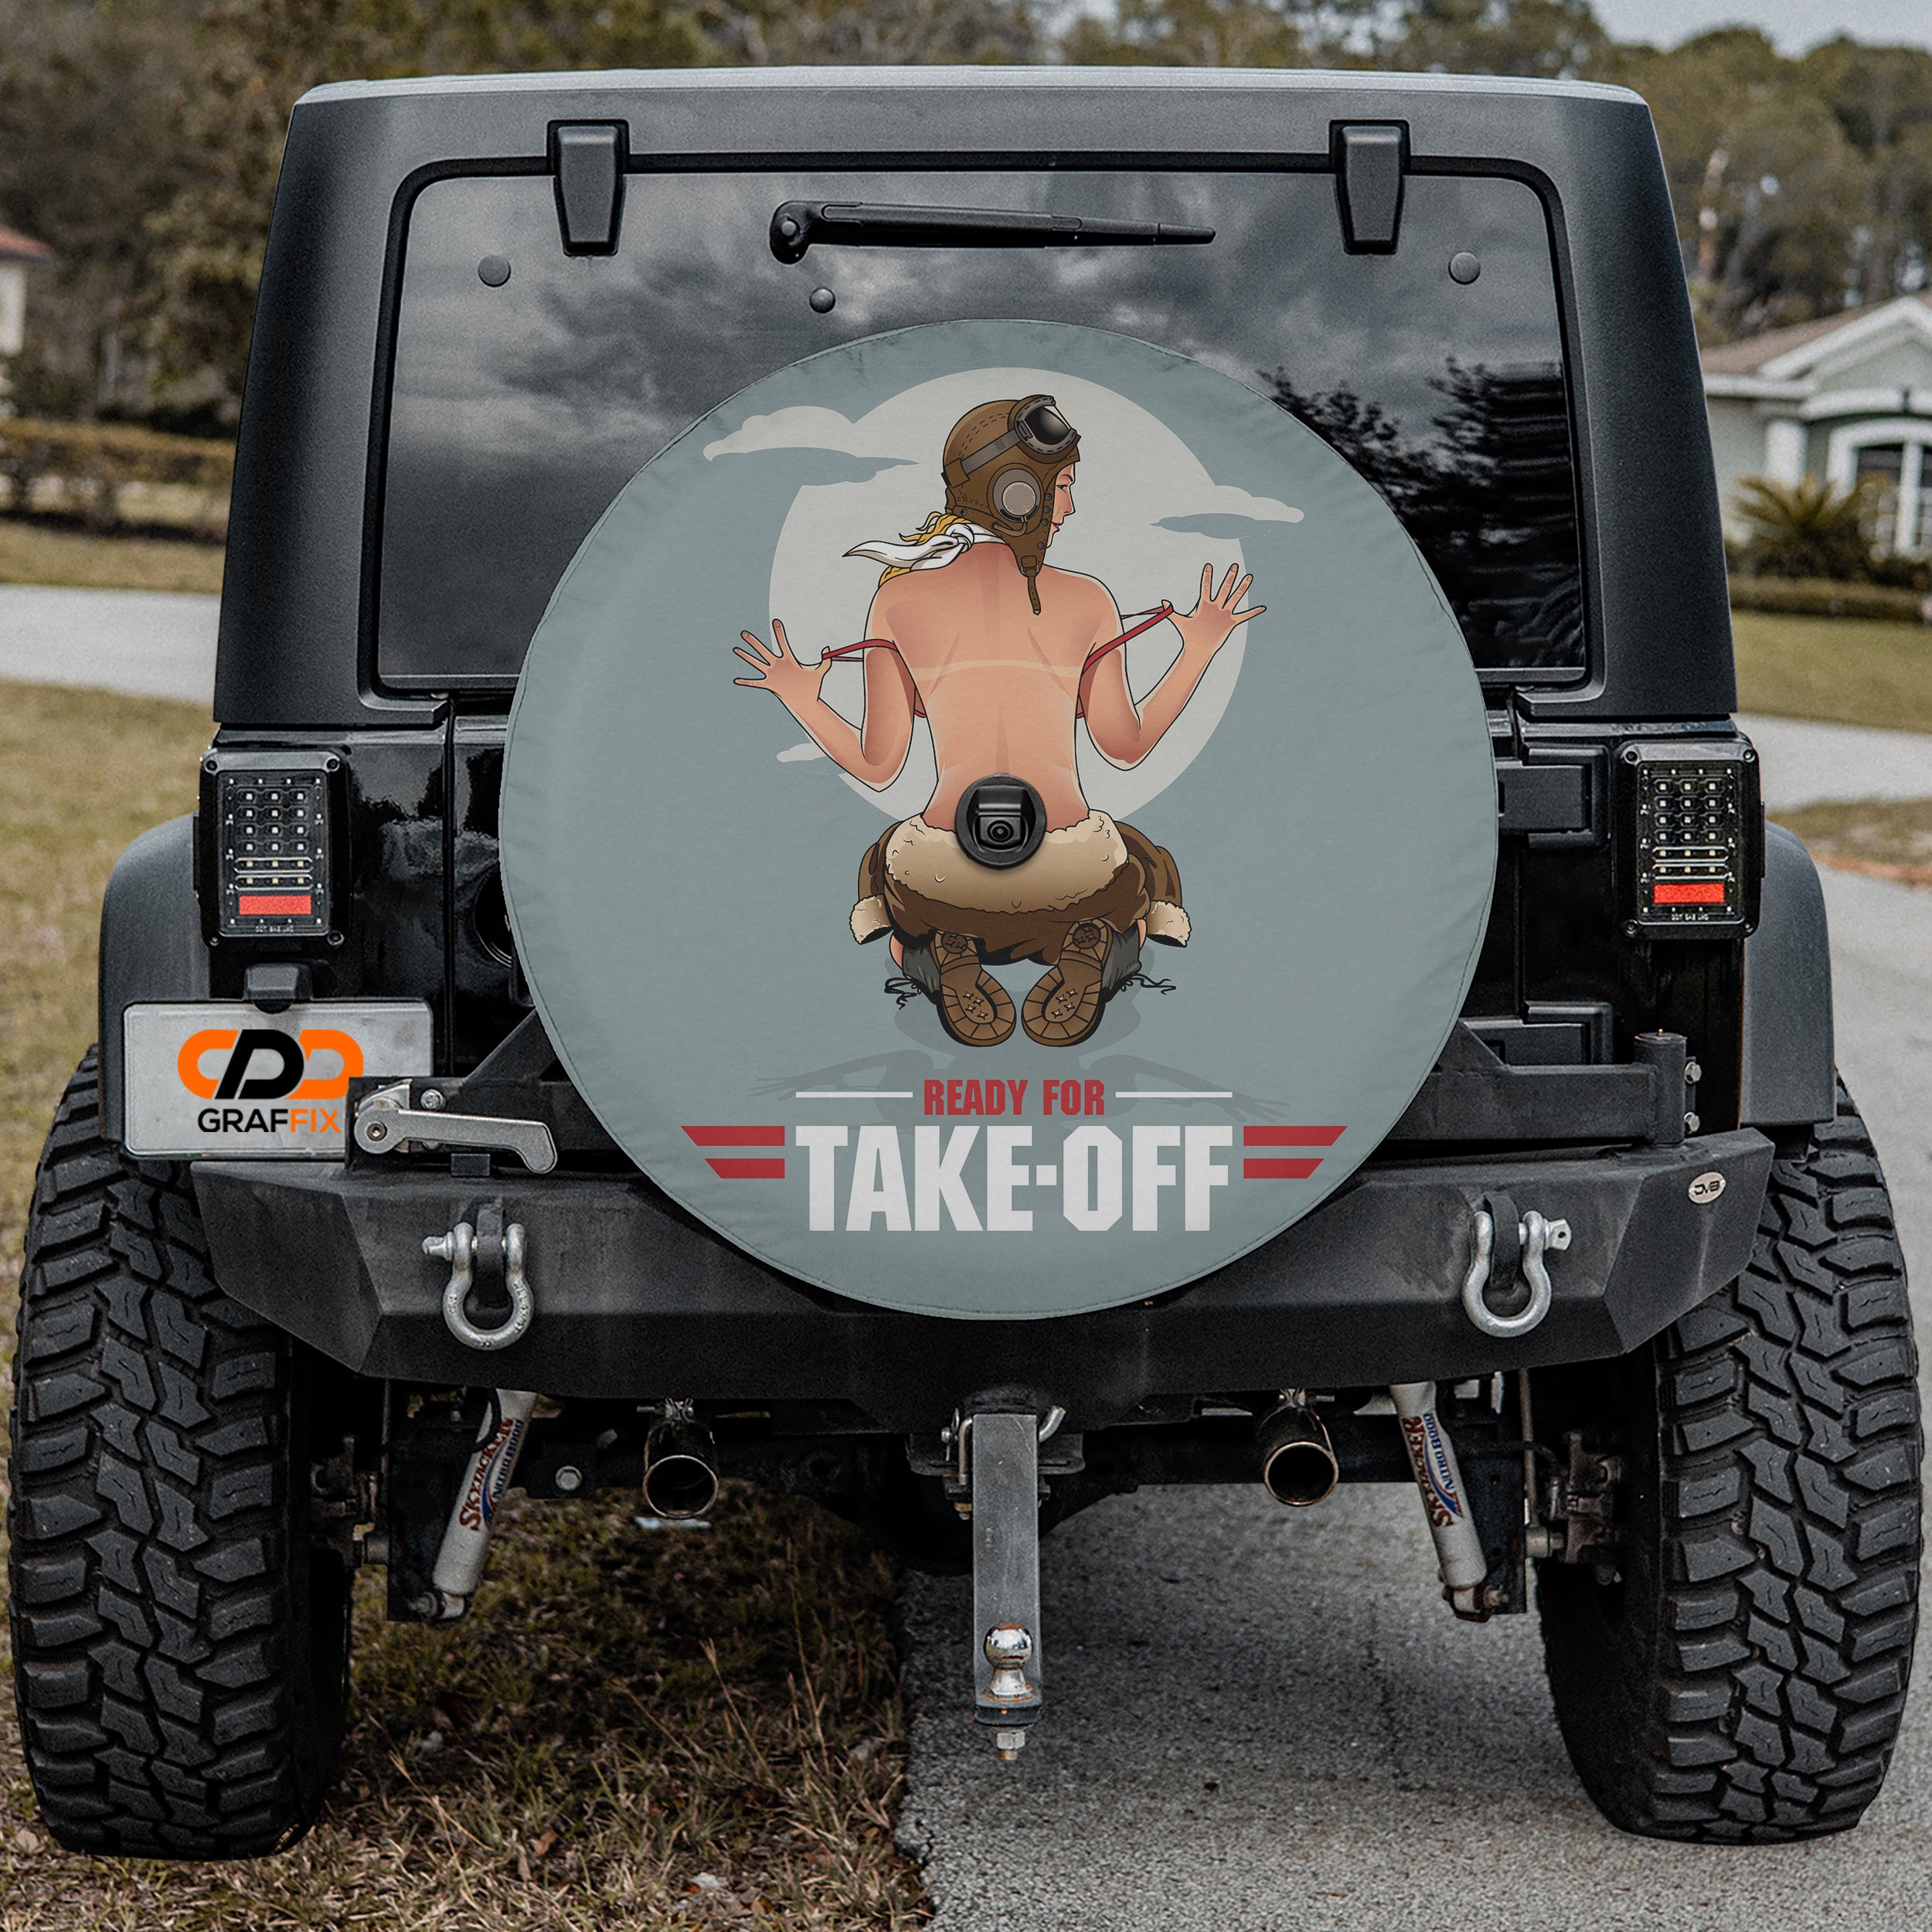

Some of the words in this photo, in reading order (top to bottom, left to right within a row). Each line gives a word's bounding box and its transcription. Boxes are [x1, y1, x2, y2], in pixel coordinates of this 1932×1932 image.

[924, 1080, 1029, 1115] READY
[1044, 1080, 1104, 1115] FOR
[198, 1108, 340, 1132] GRAFFIX
[795, 1126, 1233, 1231] TAKE-OFF
[1402, 1416, 1455, 1527] SKYJACKER
[1435, 1451, 1454, 1489] NITRO
